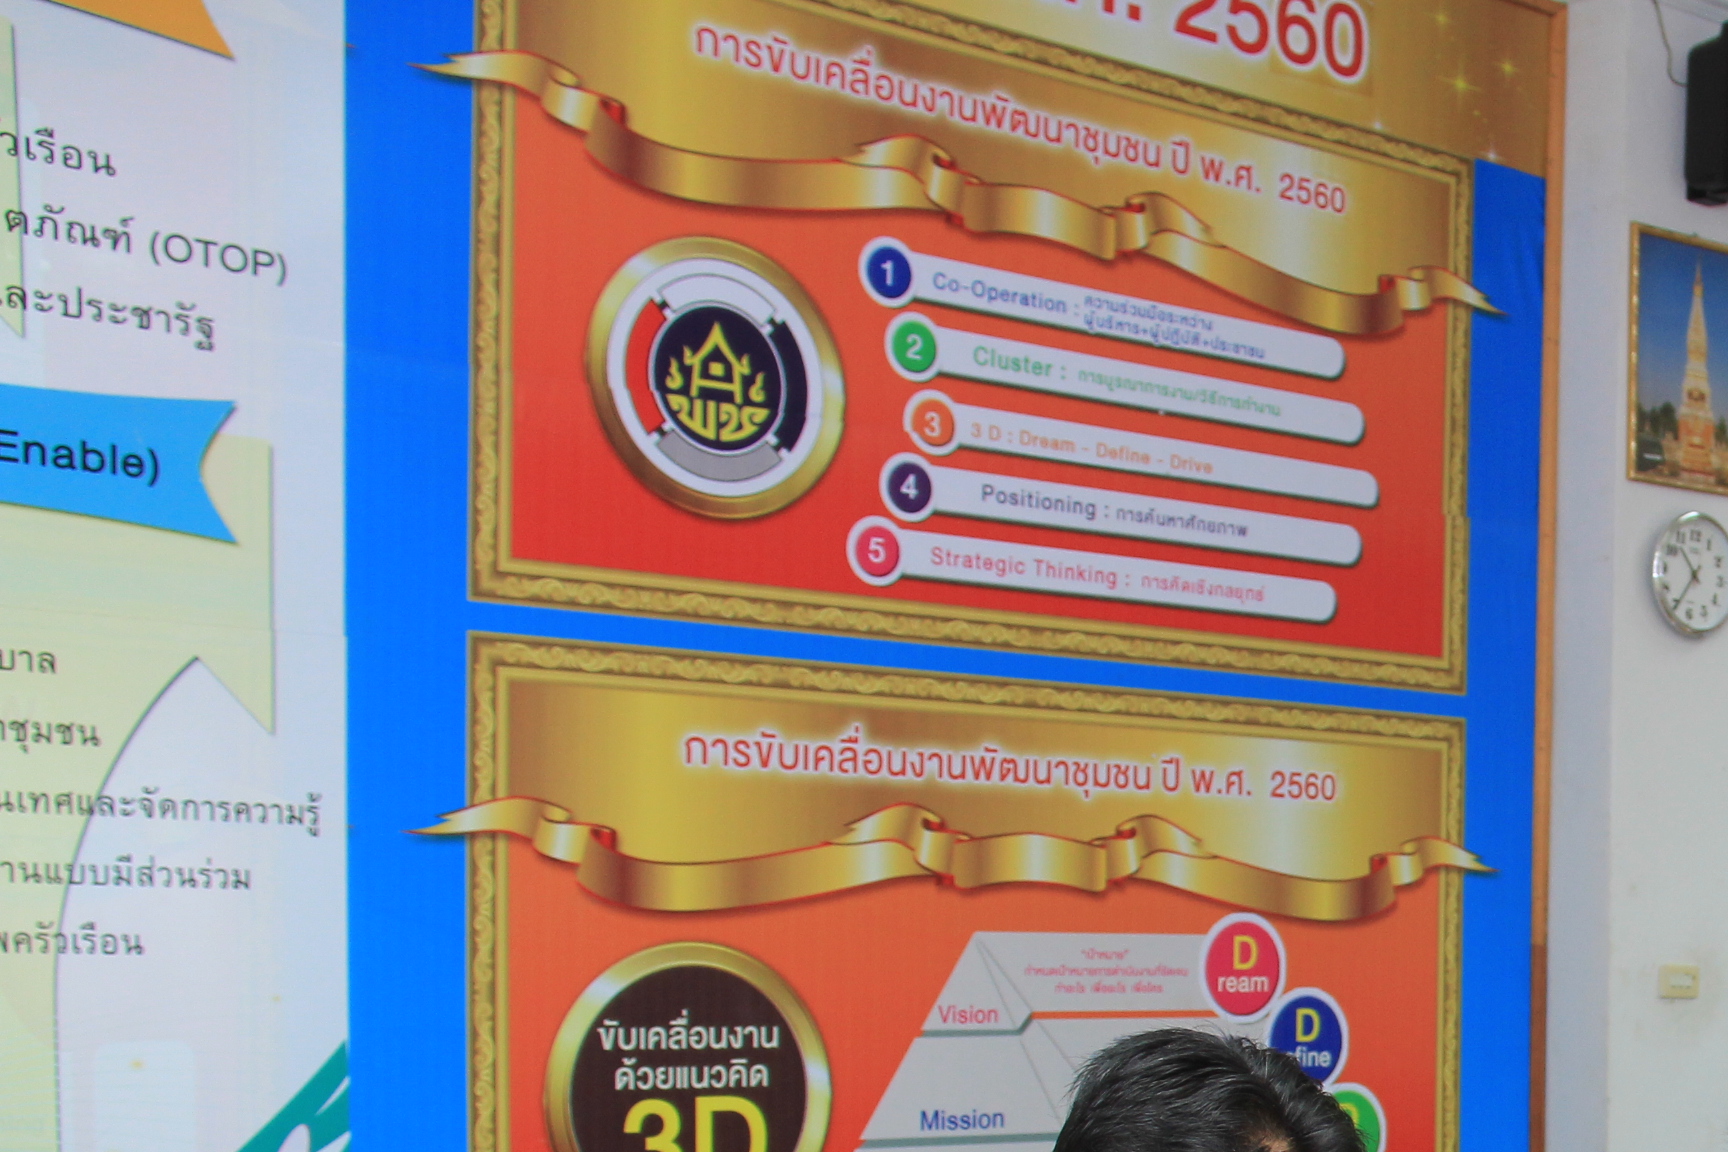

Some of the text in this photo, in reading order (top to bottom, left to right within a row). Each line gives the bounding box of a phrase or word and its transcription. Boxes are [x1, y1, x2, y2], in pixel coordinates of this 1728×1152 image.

[695, 26, 1347, 215] การขับเคลื่อนงานพัฒนาชุมชน ปี พ.ศ. 2560
[149, 231, 288, 286] (OTOP)
[881, 260, 894, 287] 1
[932, 271, 1068, 315] Co-Operation
[0, 285, 215, 352] ละประชารัฐ
[905, 333, 924, 360] 2
[972, 346, 1053, 377] Cluster
[924, 411, 941, 437] 3
[971, 422, 1213, 475] 3 D Dream Define Drive
[900, 473, 918, 499] 4
[981, 484, 1096, 520] Positioning
[867, 537, 887, 563] 5
[930, 548, 1117, 589] Strategic Thinking
[683, 724, 1337, 801] การขับเคลื่อนงานพัฒนาชุมชน ปี พ.ศ. 2560
[1217, 976, 1269, 992] ream
[597, 1009, 780, 1050] ขับเคลื่อนงาน
[938, 1004, 999, 1025] Vision
[1286, 1045, 1331, 1068] fine
[614, 1058, 769, 1091] ด้วยแนวคิด
[919, 1109, 1004, 1132] Mission
